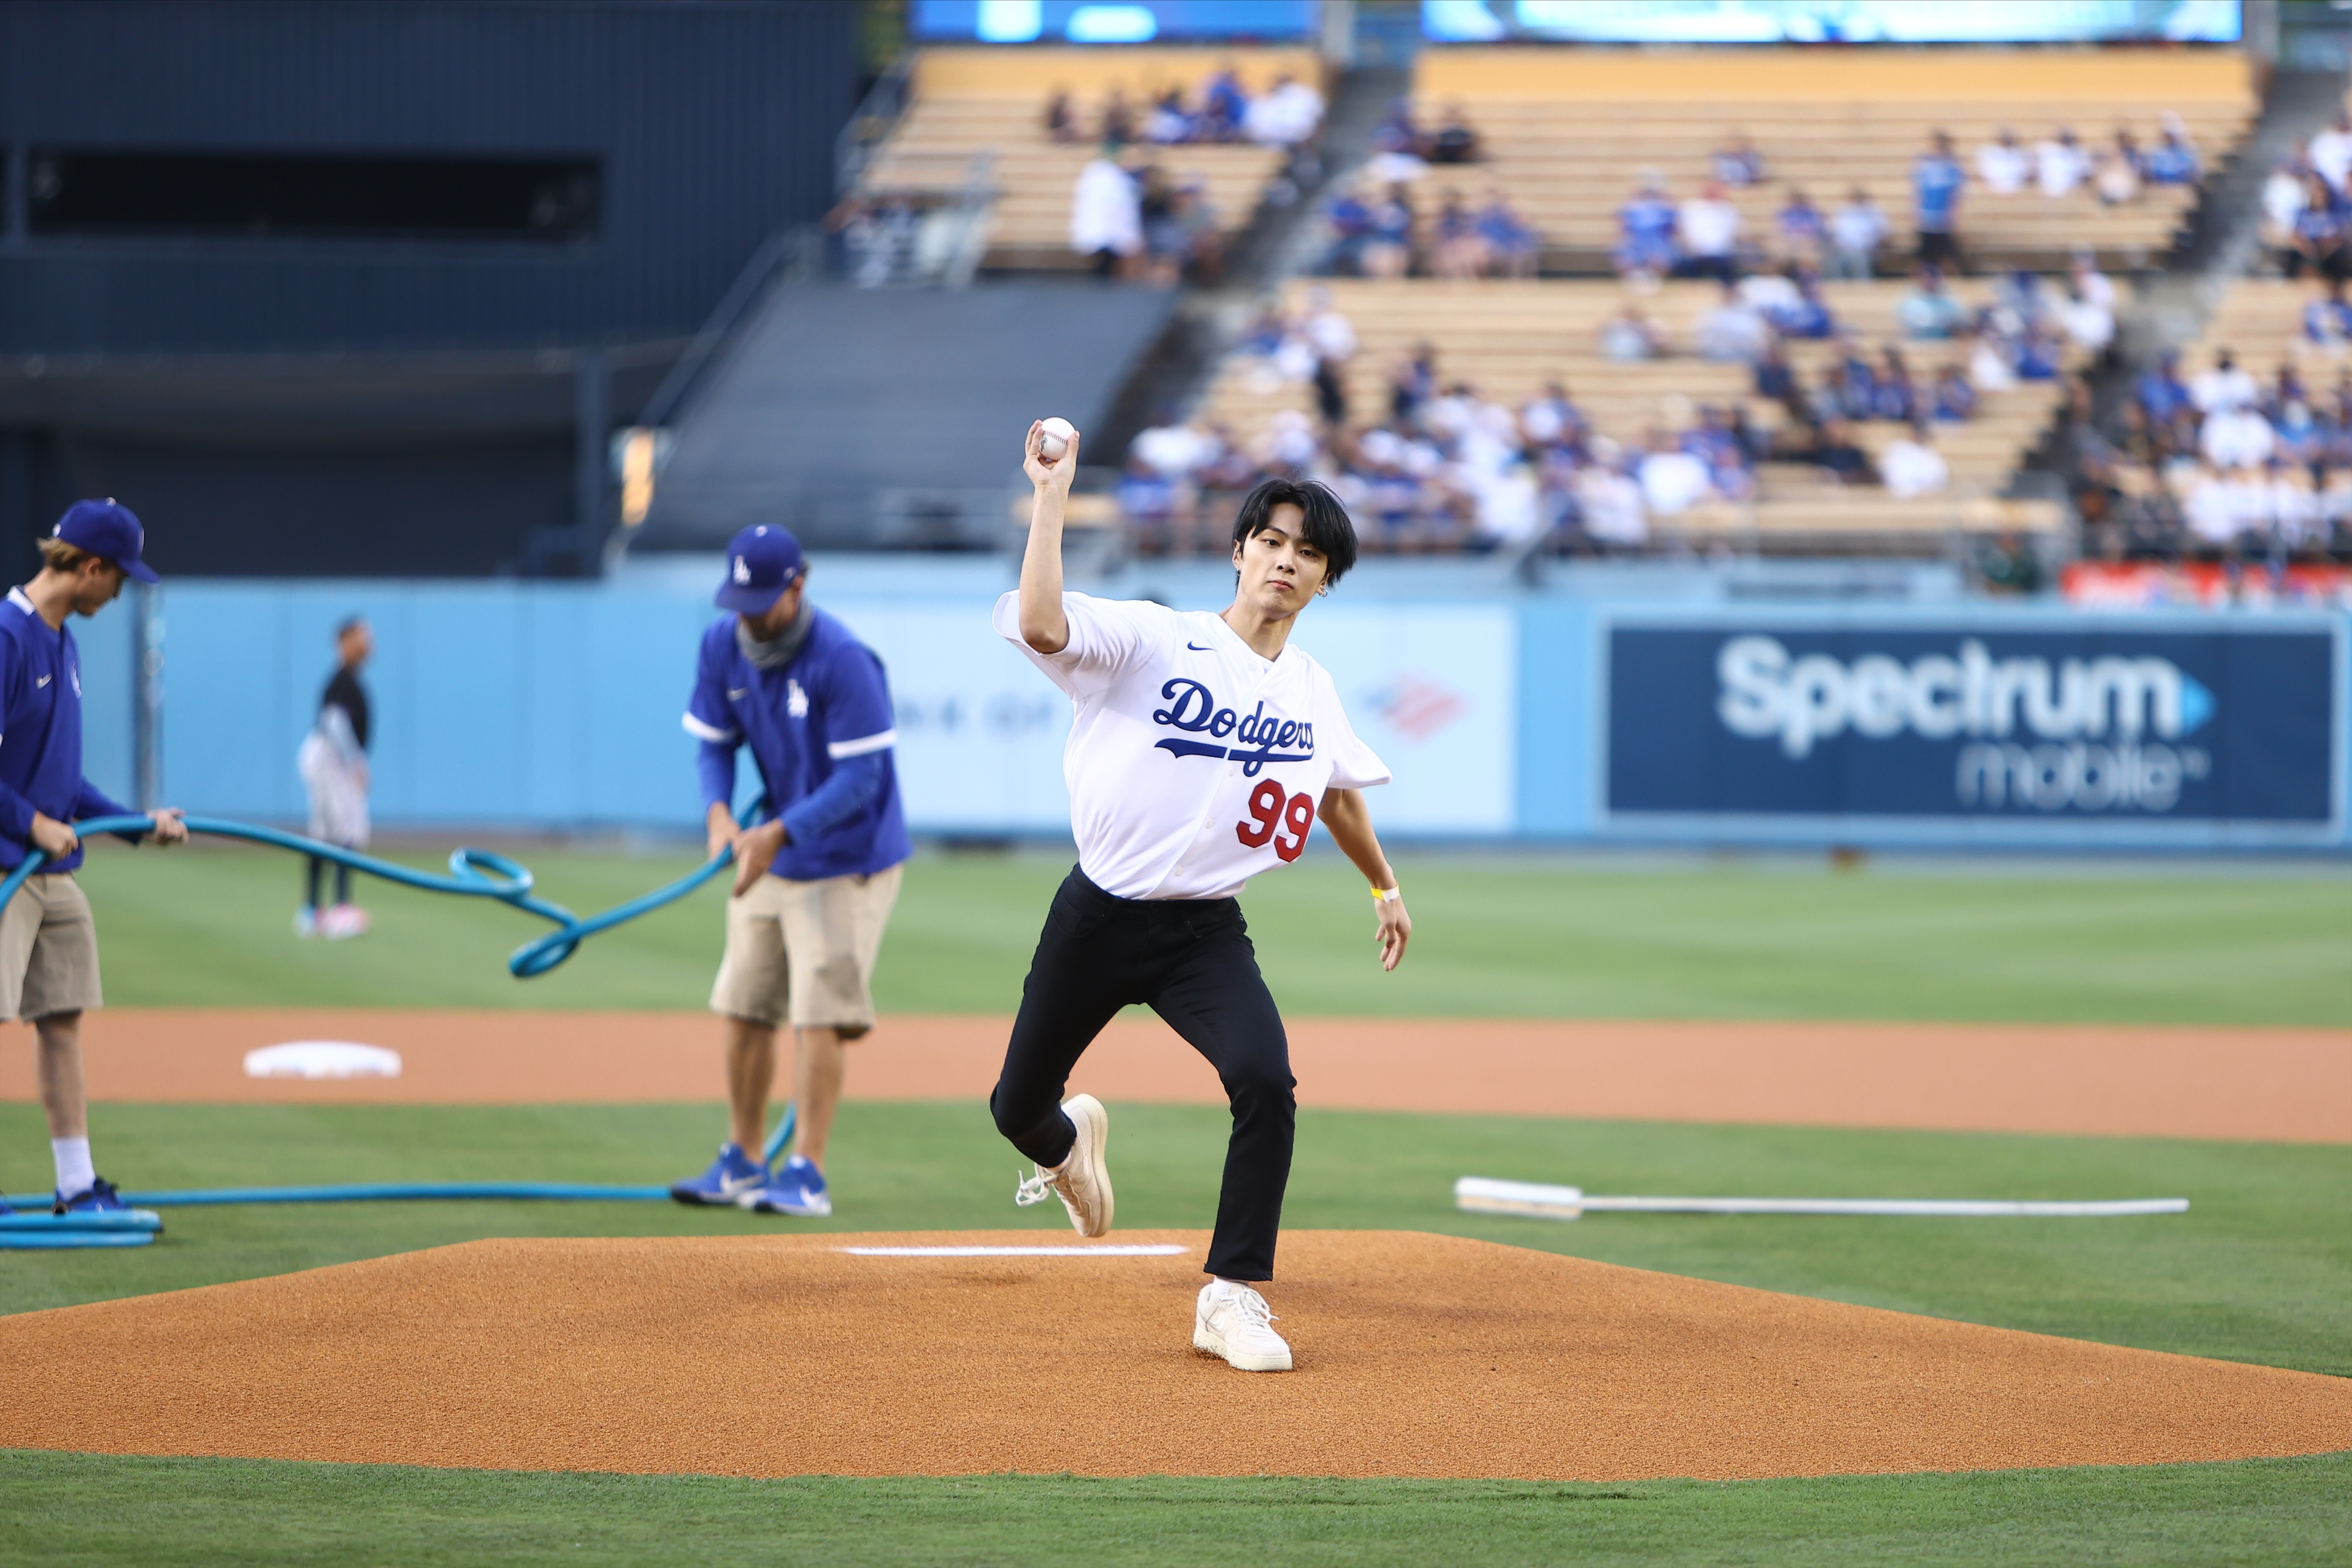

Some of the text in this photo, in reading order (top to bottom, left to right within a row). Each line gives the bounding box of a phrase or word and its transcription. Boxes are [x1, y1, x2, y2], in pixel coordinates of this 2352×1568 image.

[1153, 678, 1314, 777] Dodgers
[1715, 634, 2184, 760] Spectrum
[1236, 778, 1315, 862] 99
[1953, 741, 2183, 811] mobile
